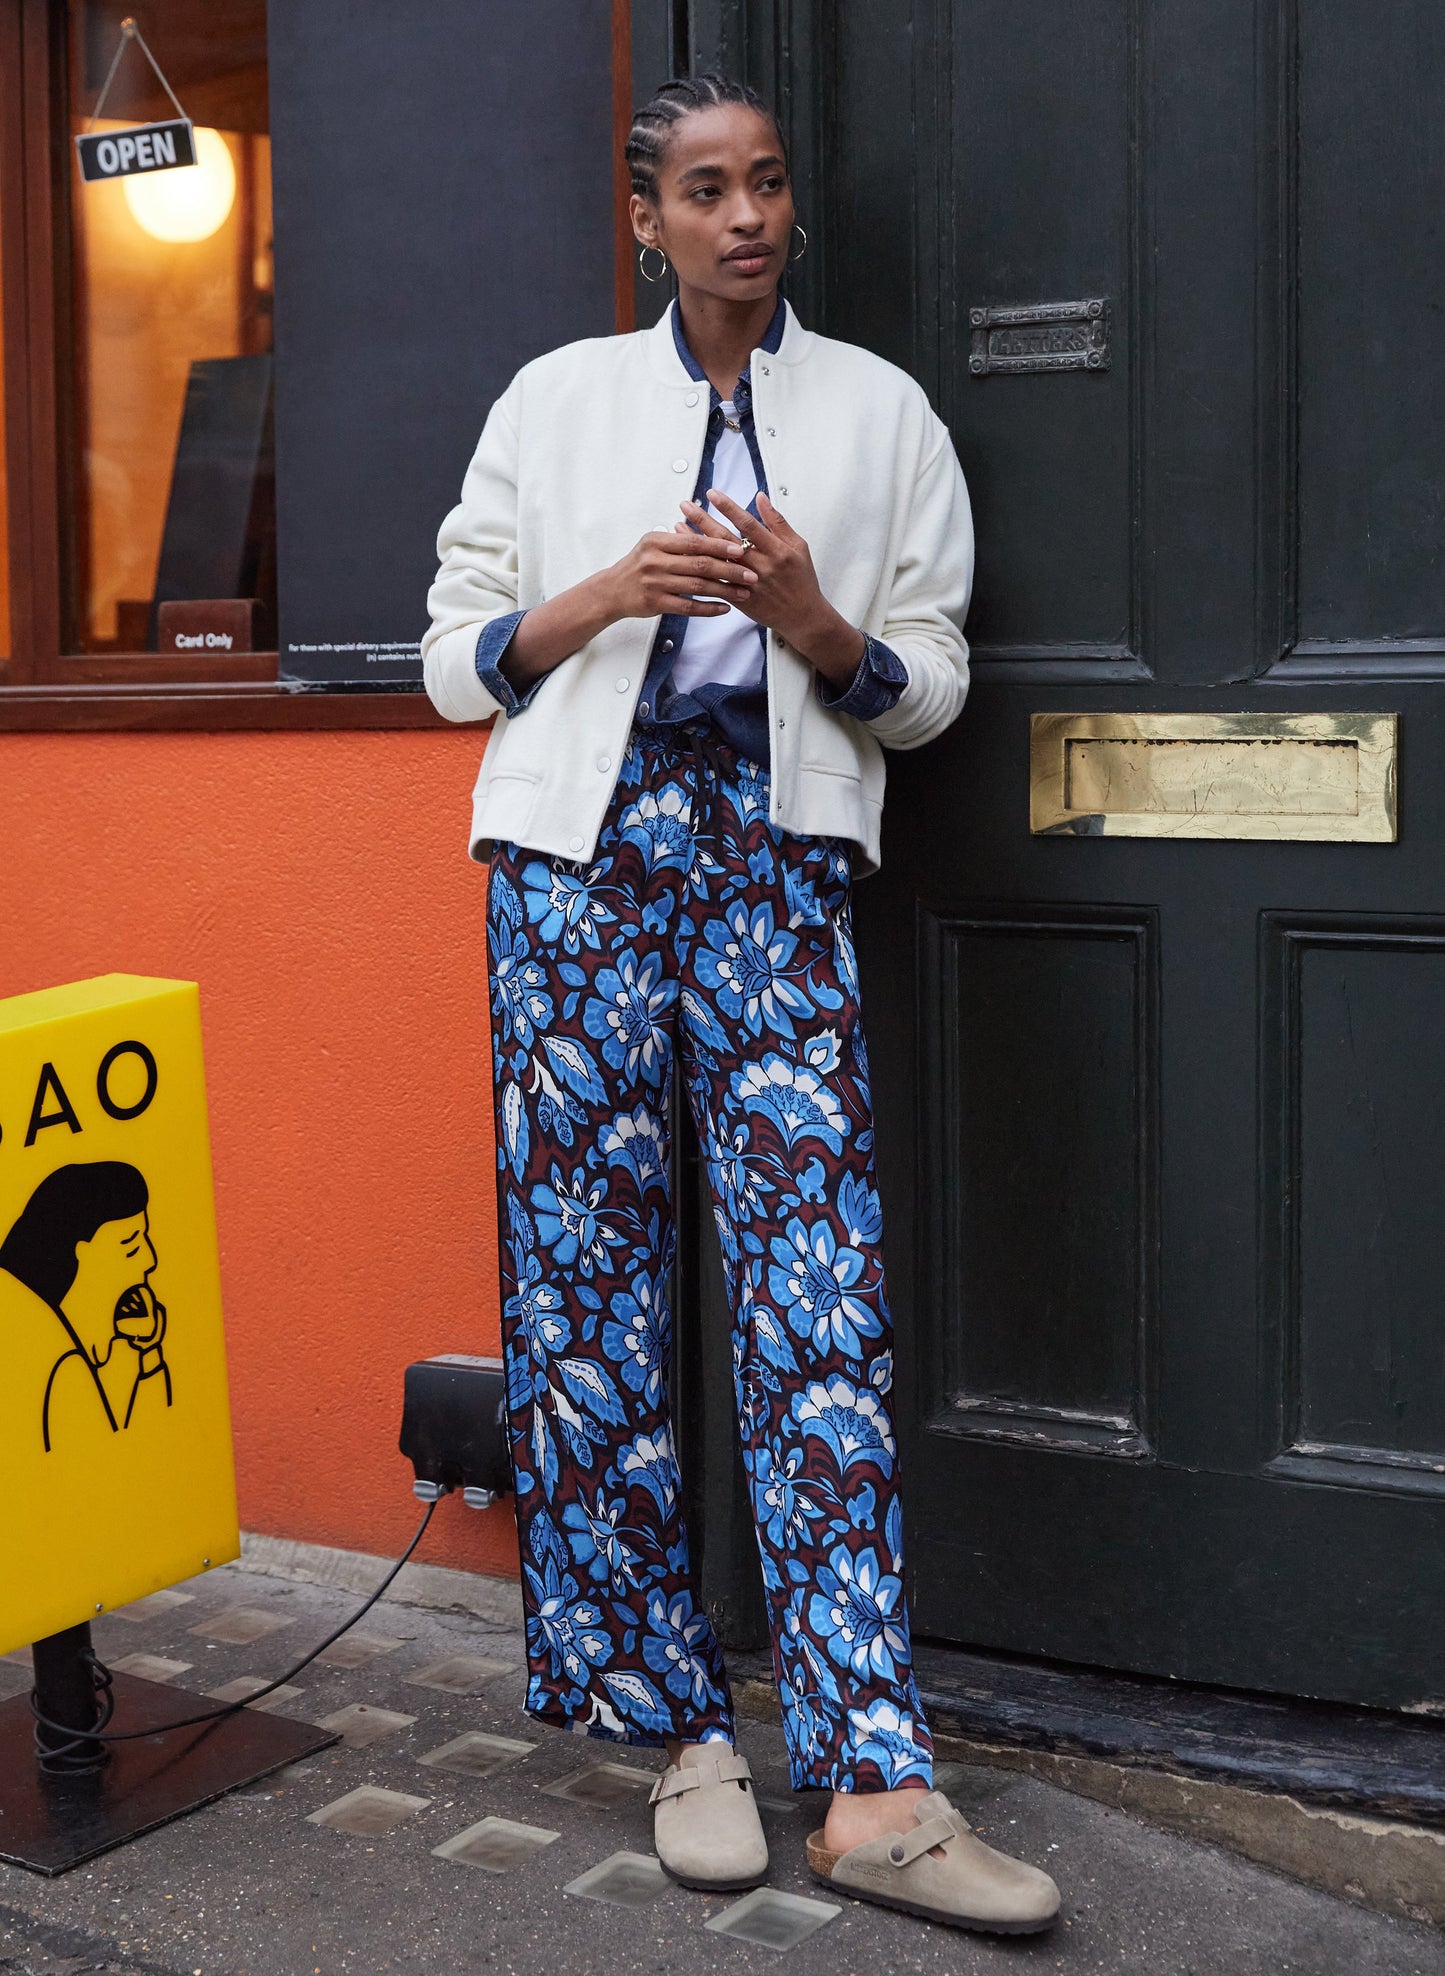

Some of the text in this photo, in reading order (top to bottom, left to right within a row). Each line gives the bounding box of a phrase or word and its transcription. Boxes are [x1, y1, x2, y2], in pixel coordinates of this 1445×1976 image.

[96, 130, 177, 174] OPEN
[991, 327, 1087, 355] LETTERS
[175, 632, 233, 650] Card Only
[288, 643, 299, 652] For
[300, 643, 317, 652] those
[318, 642, 333, 651] with
[333, 642, 355, 652] special
[356, 641, 379, 652] dietary
[377, 652, 406, 661] contains
[0, 1040, 158, 1147] AO
